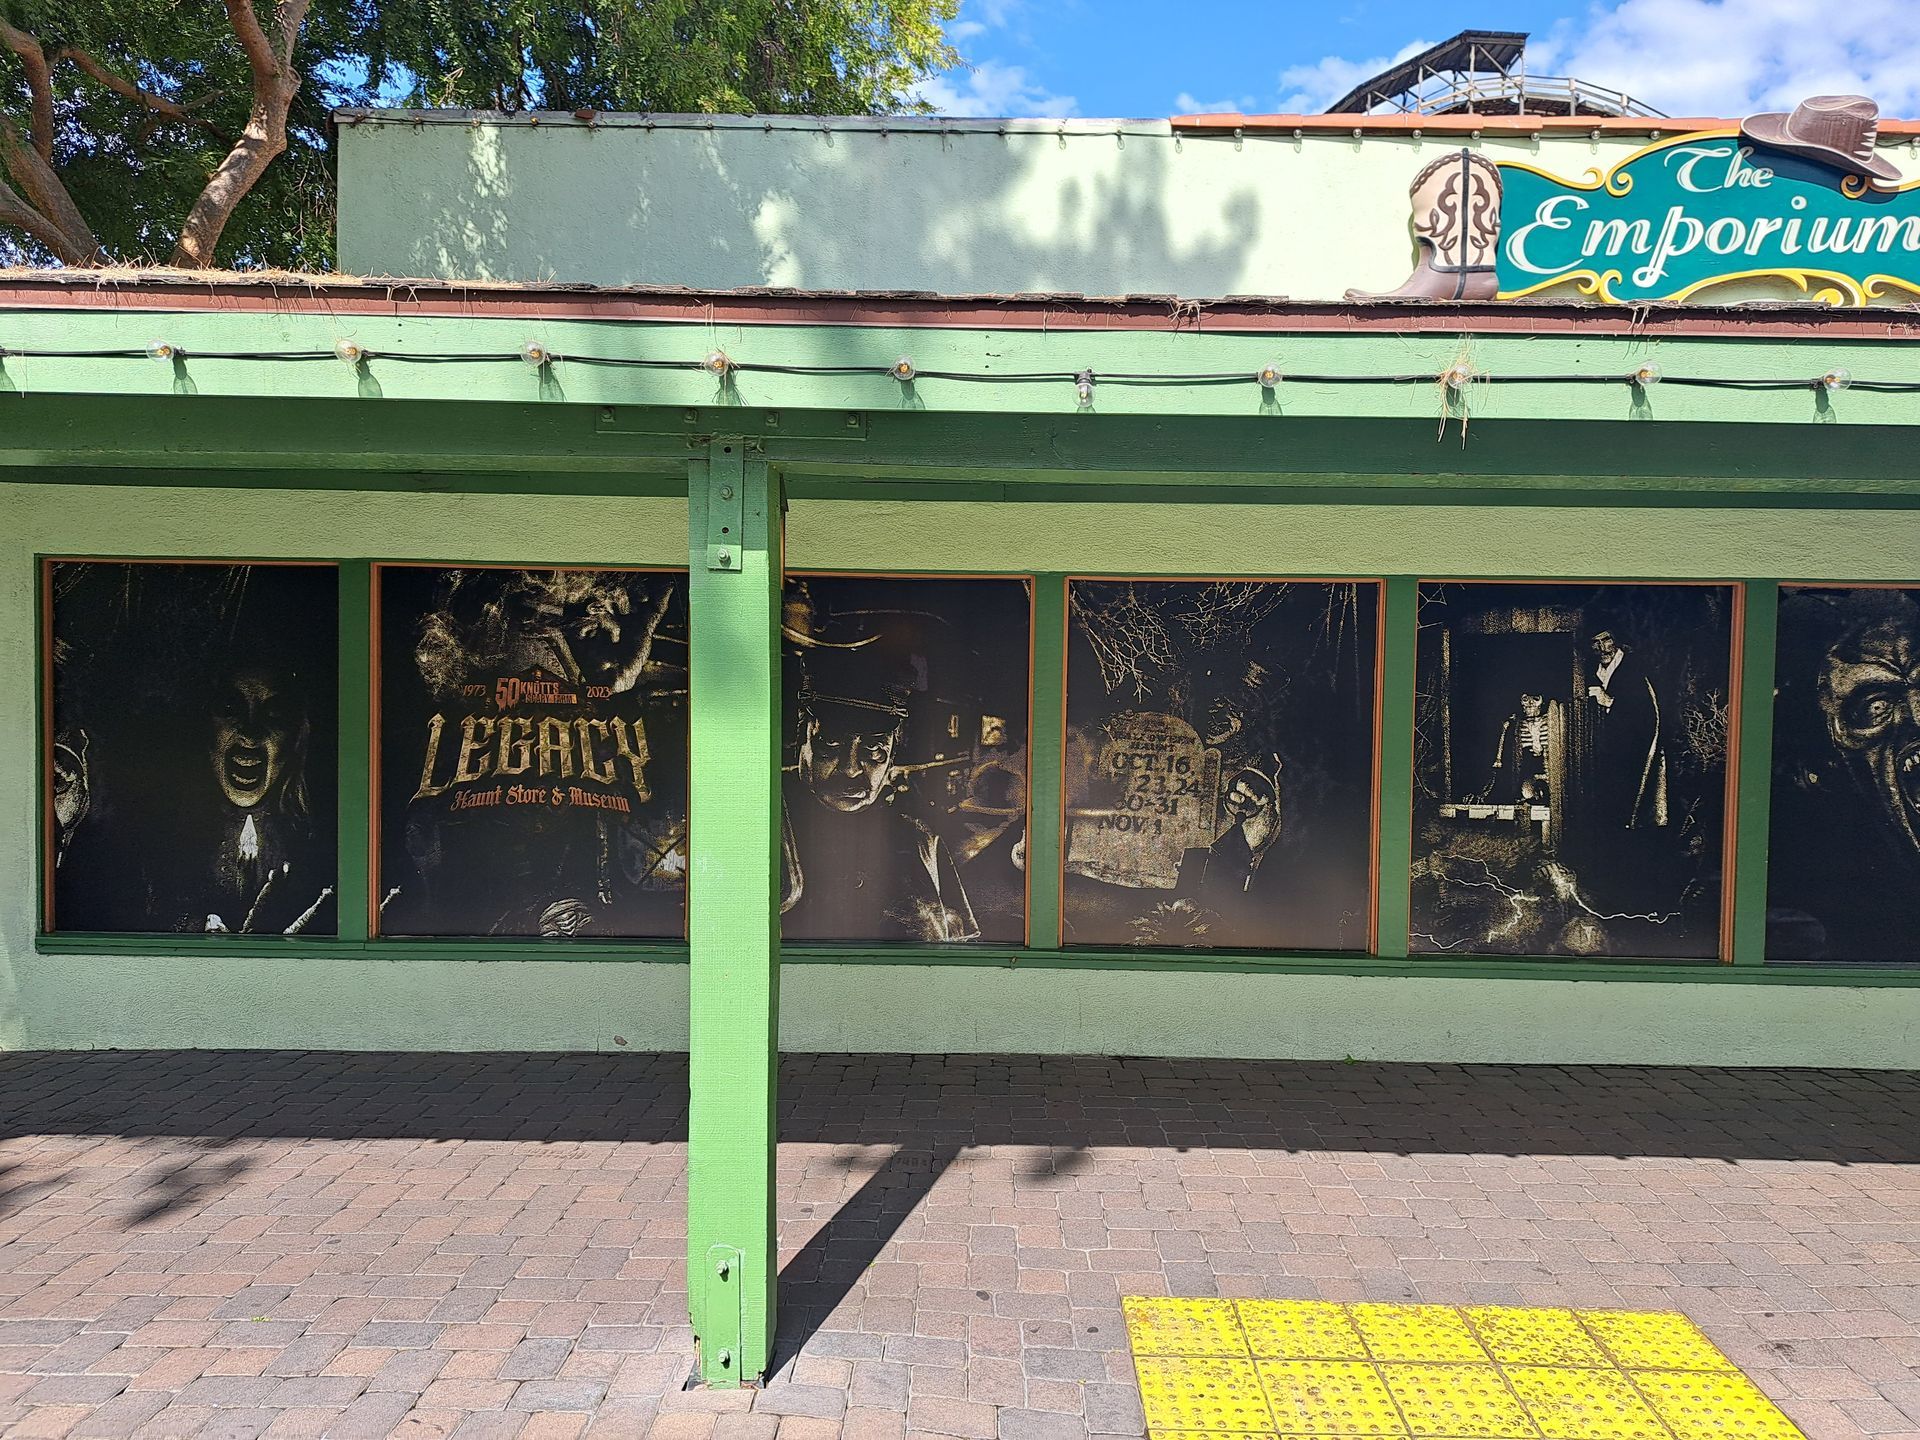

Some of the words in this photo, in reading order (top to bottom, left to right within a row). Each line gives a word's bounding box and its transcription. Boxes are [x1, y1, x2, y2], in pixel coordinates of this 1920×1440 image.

[1665, 147, 1774, 193] The
[1506, 195, 1920, 288] Emporium
[463, 684, 487, 697] 1973
[495, 677, 520, 711] 50
[586, 685, 611, 698] 2023
[409, 712, 652, 804] LEGACY
[450, 784, 502, 812] Haunt
[505, 783, 546, 805] Store
[551, 785, 565, 806] &
[568, 786, 631, 813] Museum
